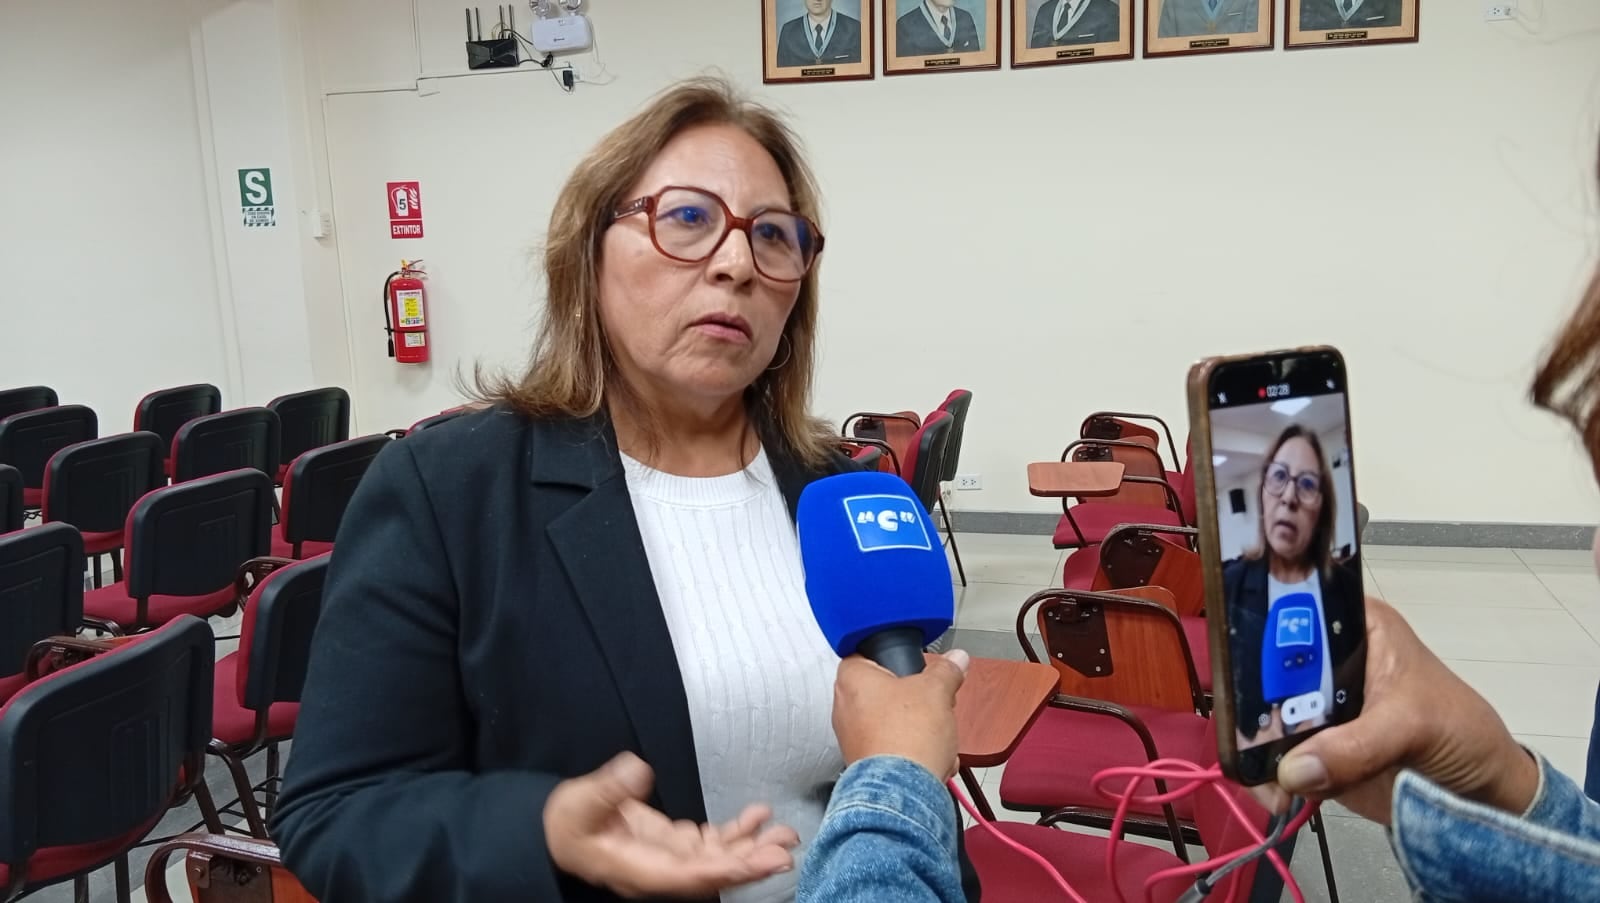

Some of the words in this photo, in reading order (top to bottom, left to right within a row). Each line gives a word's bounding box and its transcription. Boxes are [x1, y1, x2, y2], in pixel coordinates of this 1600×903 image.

[245, 170, 267, 204] S
[399, 198, 406, 210] 5
[393, 224, 421, 235] EXTINTOR
